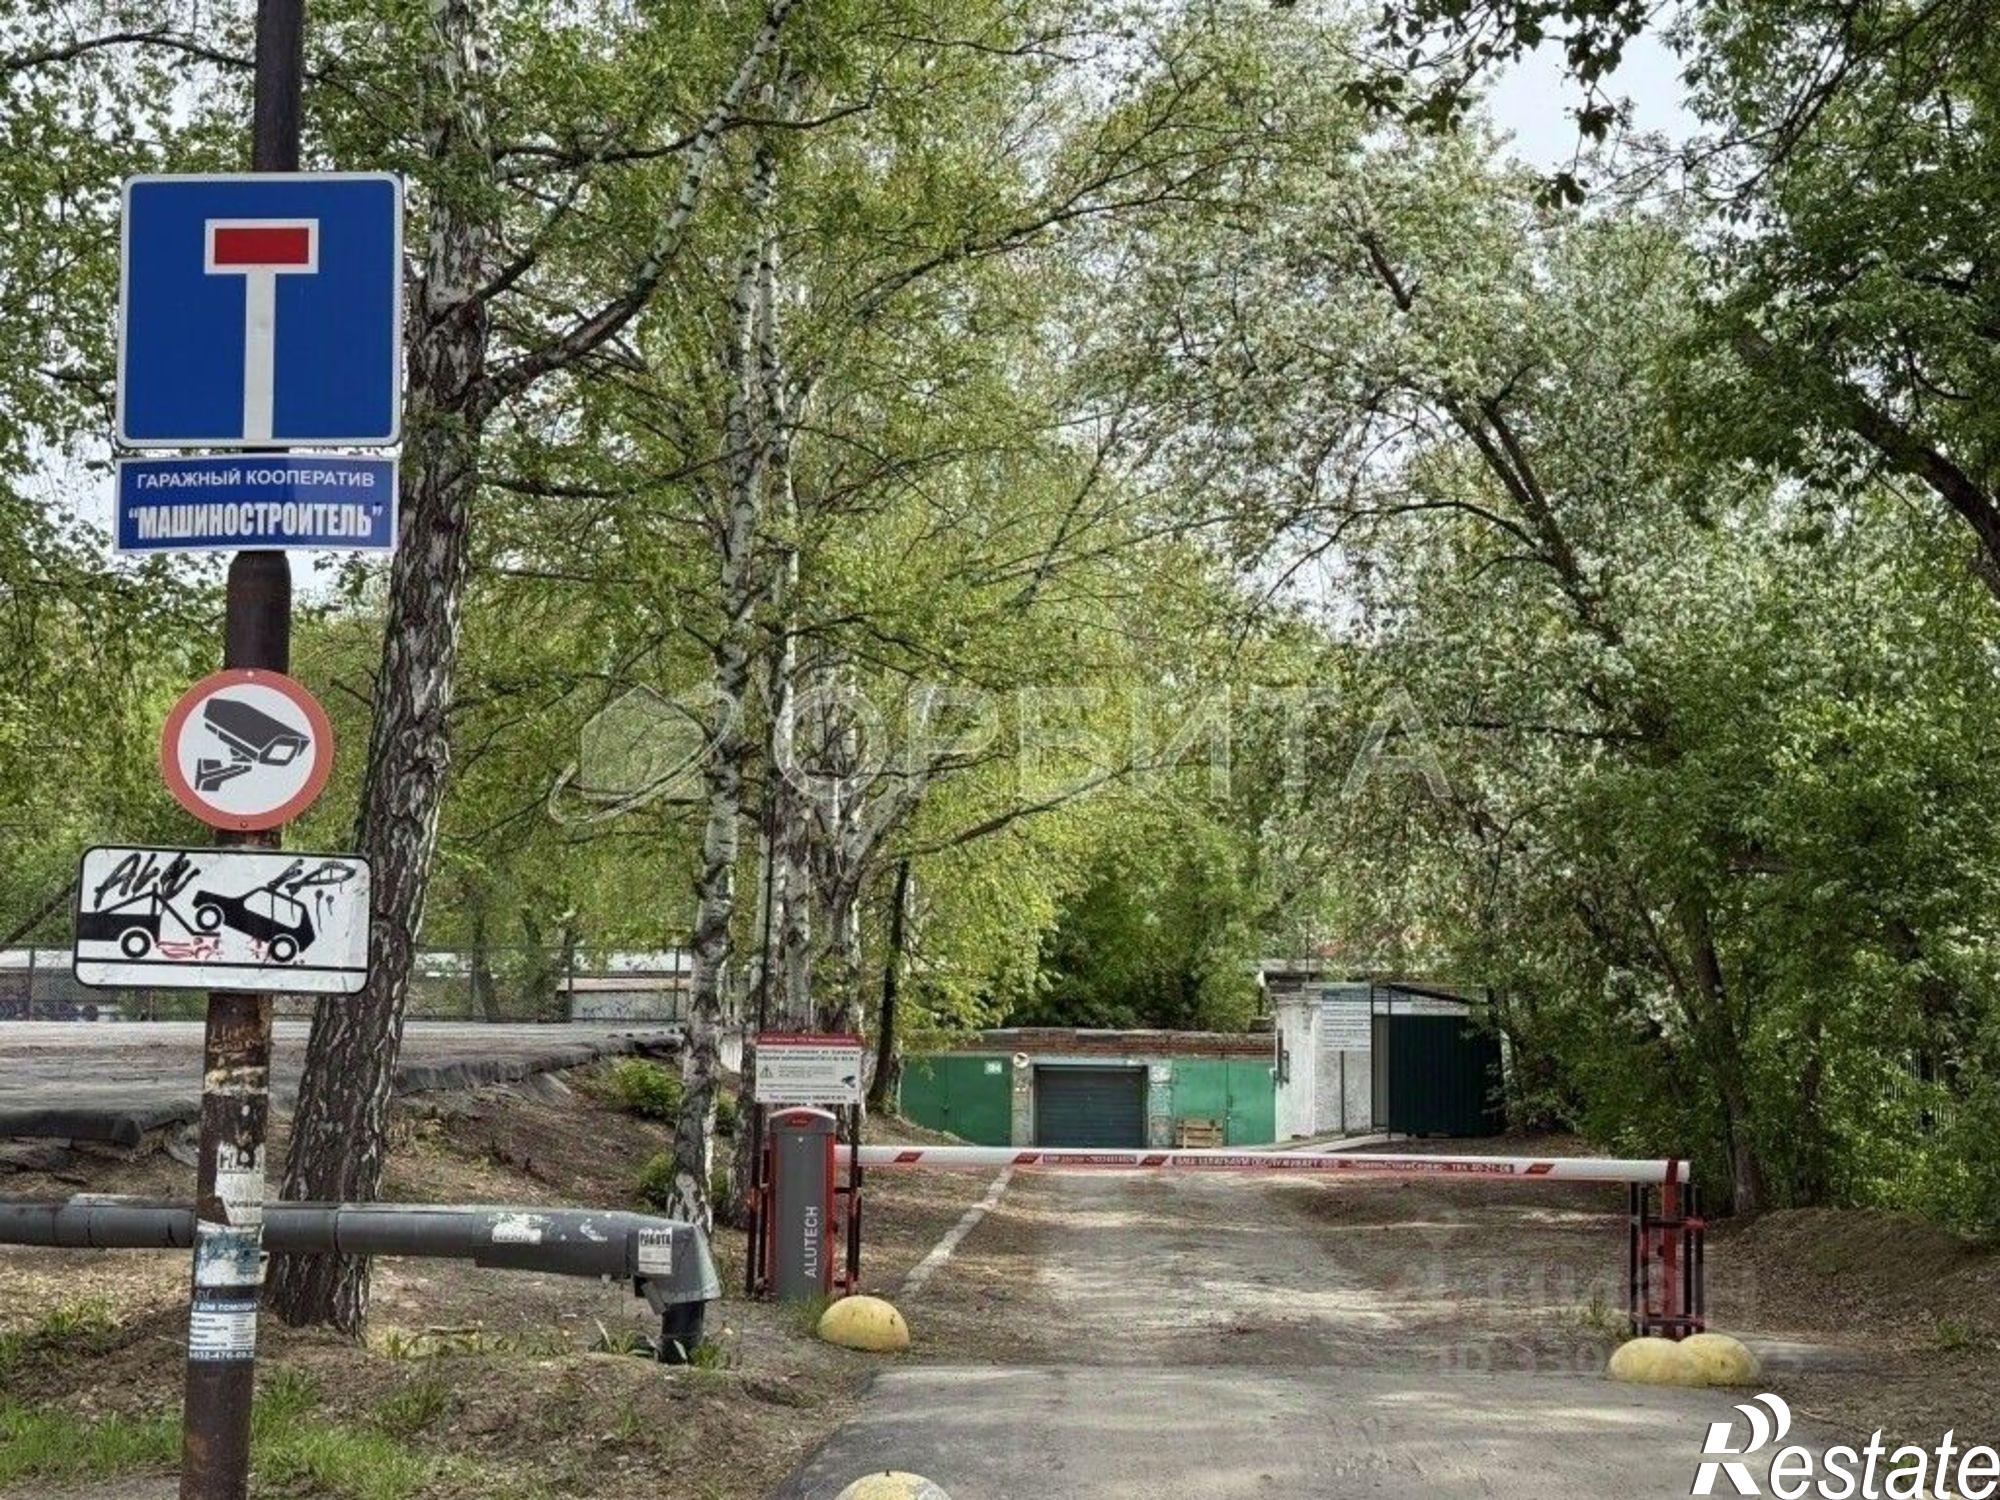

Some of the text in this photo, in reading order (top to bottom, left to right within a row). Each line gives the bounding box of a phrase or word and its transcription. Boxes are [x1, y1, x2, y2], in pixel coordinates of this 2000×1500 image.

[137, 468, 376, 489] ГАРАЖНЫЙ КООПЕРАТИВ
[804, 1206, 818, 1278] ALUTECH
